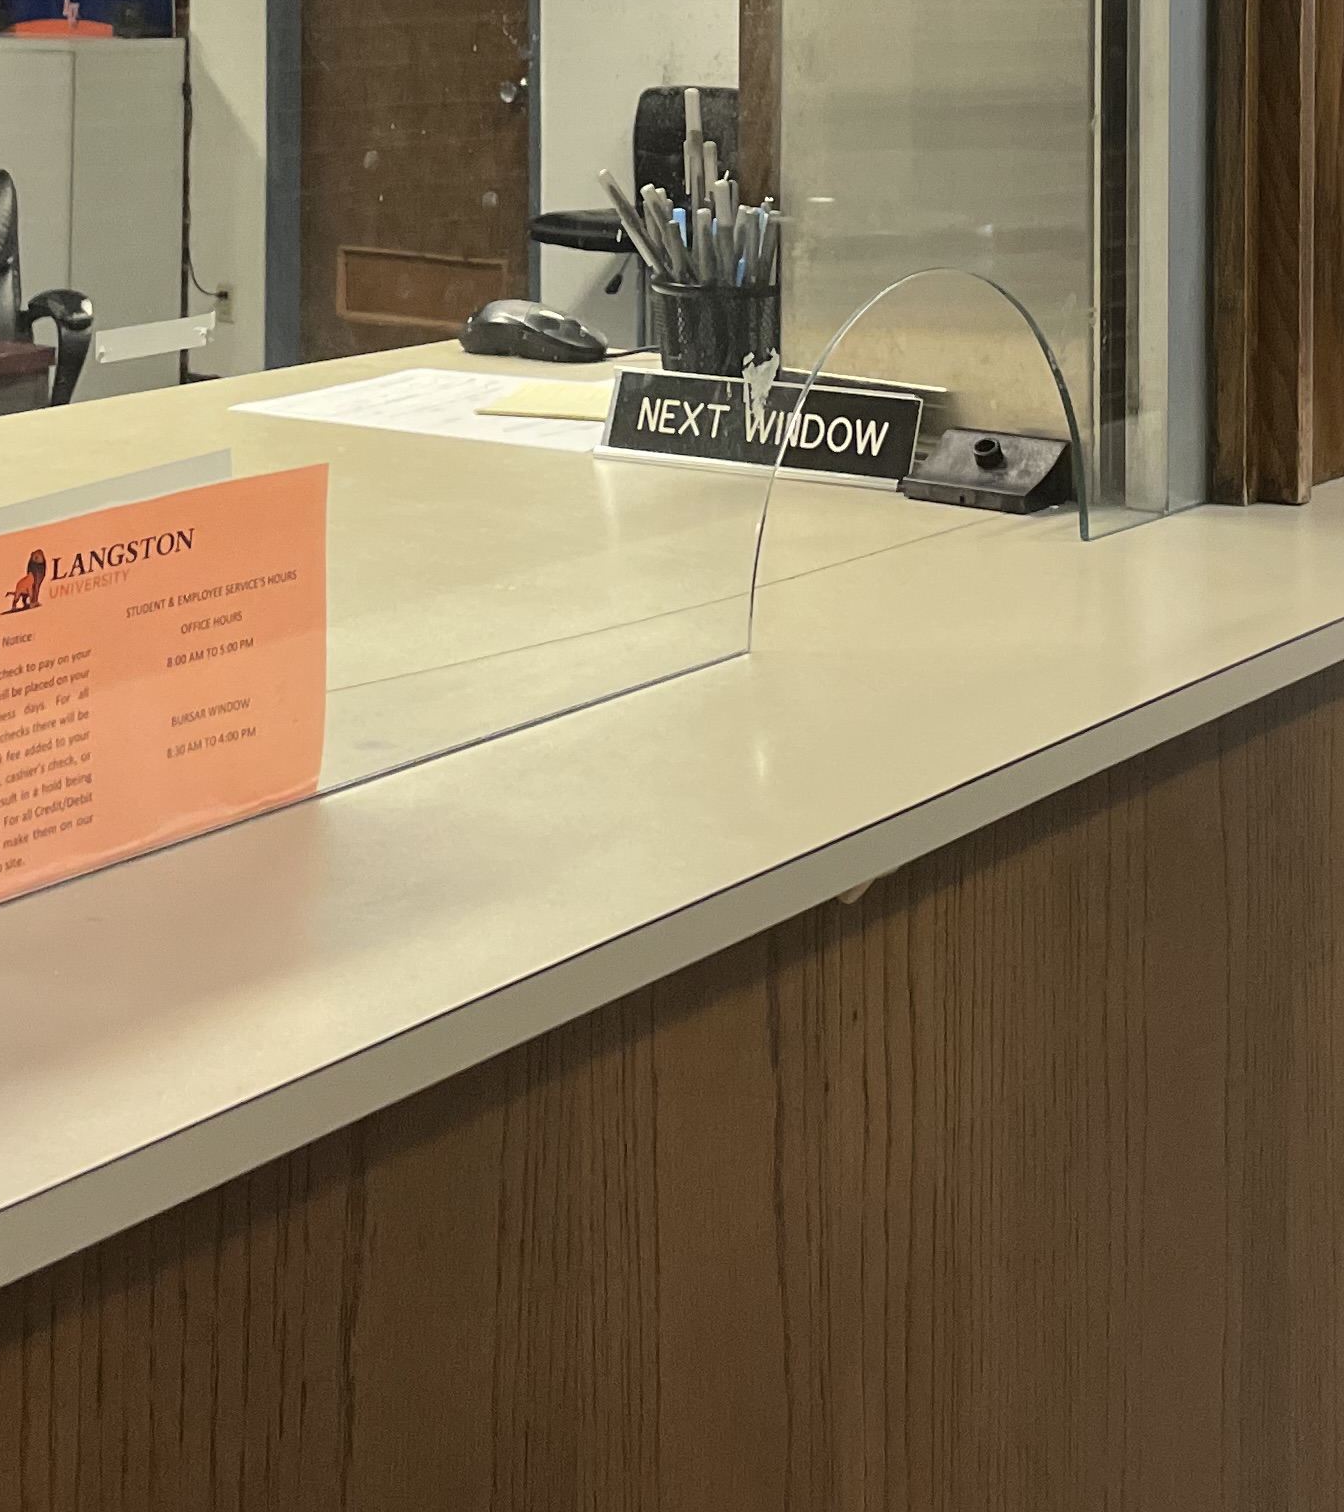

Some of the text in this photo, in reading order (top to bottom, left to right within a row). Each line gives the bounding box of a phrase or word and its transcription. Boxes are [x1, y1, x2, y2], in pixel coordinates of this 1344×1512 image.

[637, 397, 890, 457] NEXT WINDOW
[51, 528, 192, 580] LANGSTON
[48, 568, 129, 599] UNIVERSITY
[180, 610, 242, 634] OFFICE HOURS
